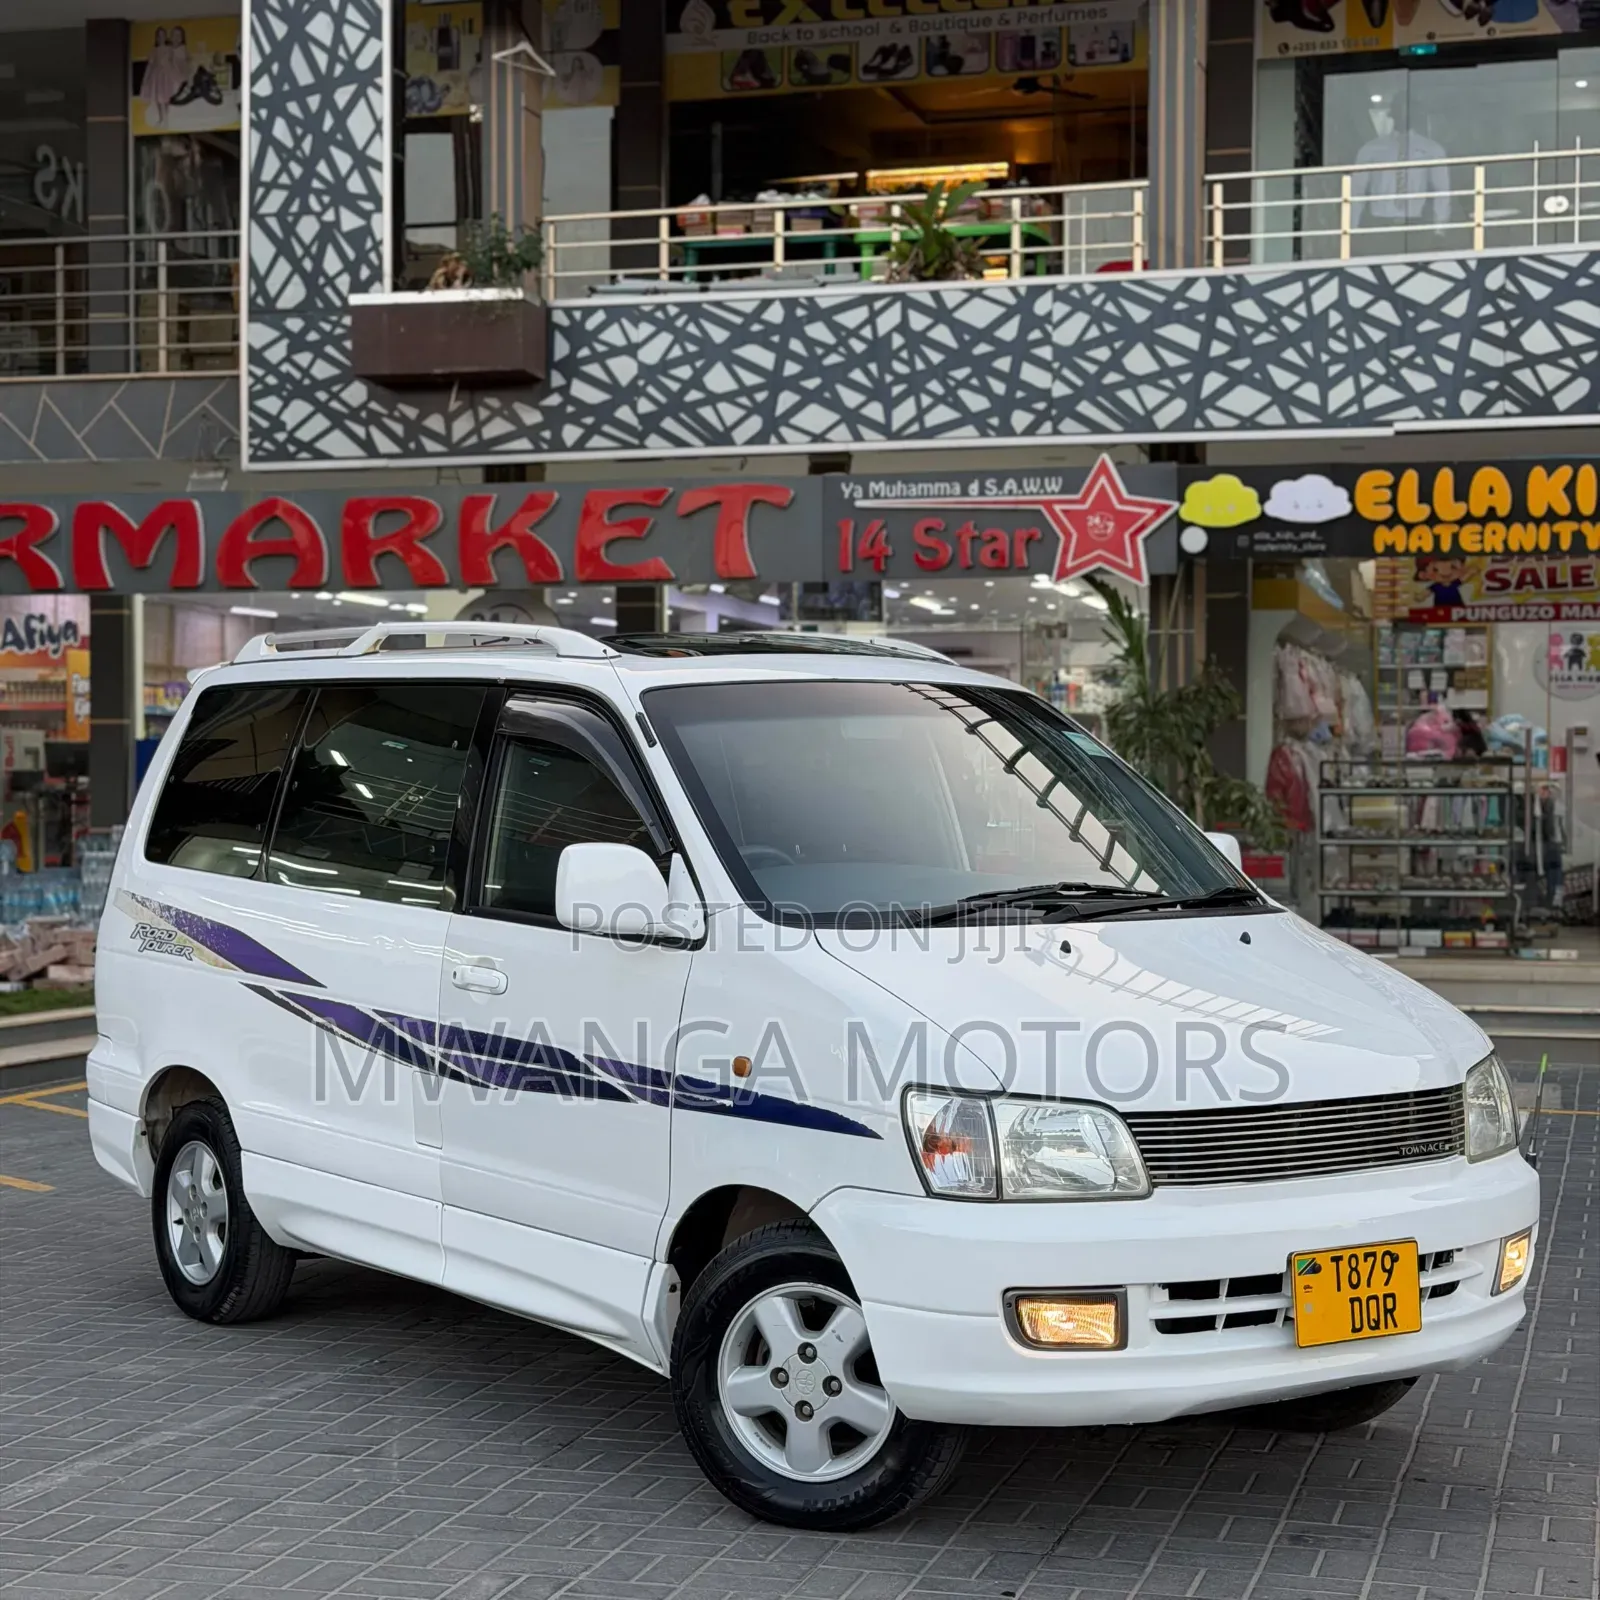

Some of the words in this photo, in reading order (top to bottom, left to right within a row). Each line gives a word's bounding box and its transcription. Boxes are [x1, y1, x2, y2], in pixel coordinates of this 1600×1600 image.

[747, 26, 790, 44] Back
[796, 28, 814, 41] to
[819, 21, 880, 40] school
[889, 21, 902, 35] &
[909, 14, 992, 36] Boutique
[998, 13, 1011, 26] &
[1016, 5, 1108, 25] Perfumes
[840, 481, 863, 499] Ya
[984, 476, 1063, 496] S.A.W.W
[1355, 466, 1512, 523] ELLA
[1526, 463, 1598, 518] KI
[837, 517, 892, 572] 14
[912, 517, 1043, 572] Star
[1373, 520, 1600, 554] MATERNITY
[1484, 562, 1595, 593] SALE
[1451, 604, 1555, 622] PUNGUZO
[2, 613, 80, 656] Afiya
[130, 922, 177, 941] ROAD
[138, 938, 194, 961] TOURER
[1400, 1142, 1445, 1156] TOWNACE
[1330, 1250, 1397, 1292] T879
[1349, 1292, 1398, 1334] DQR
